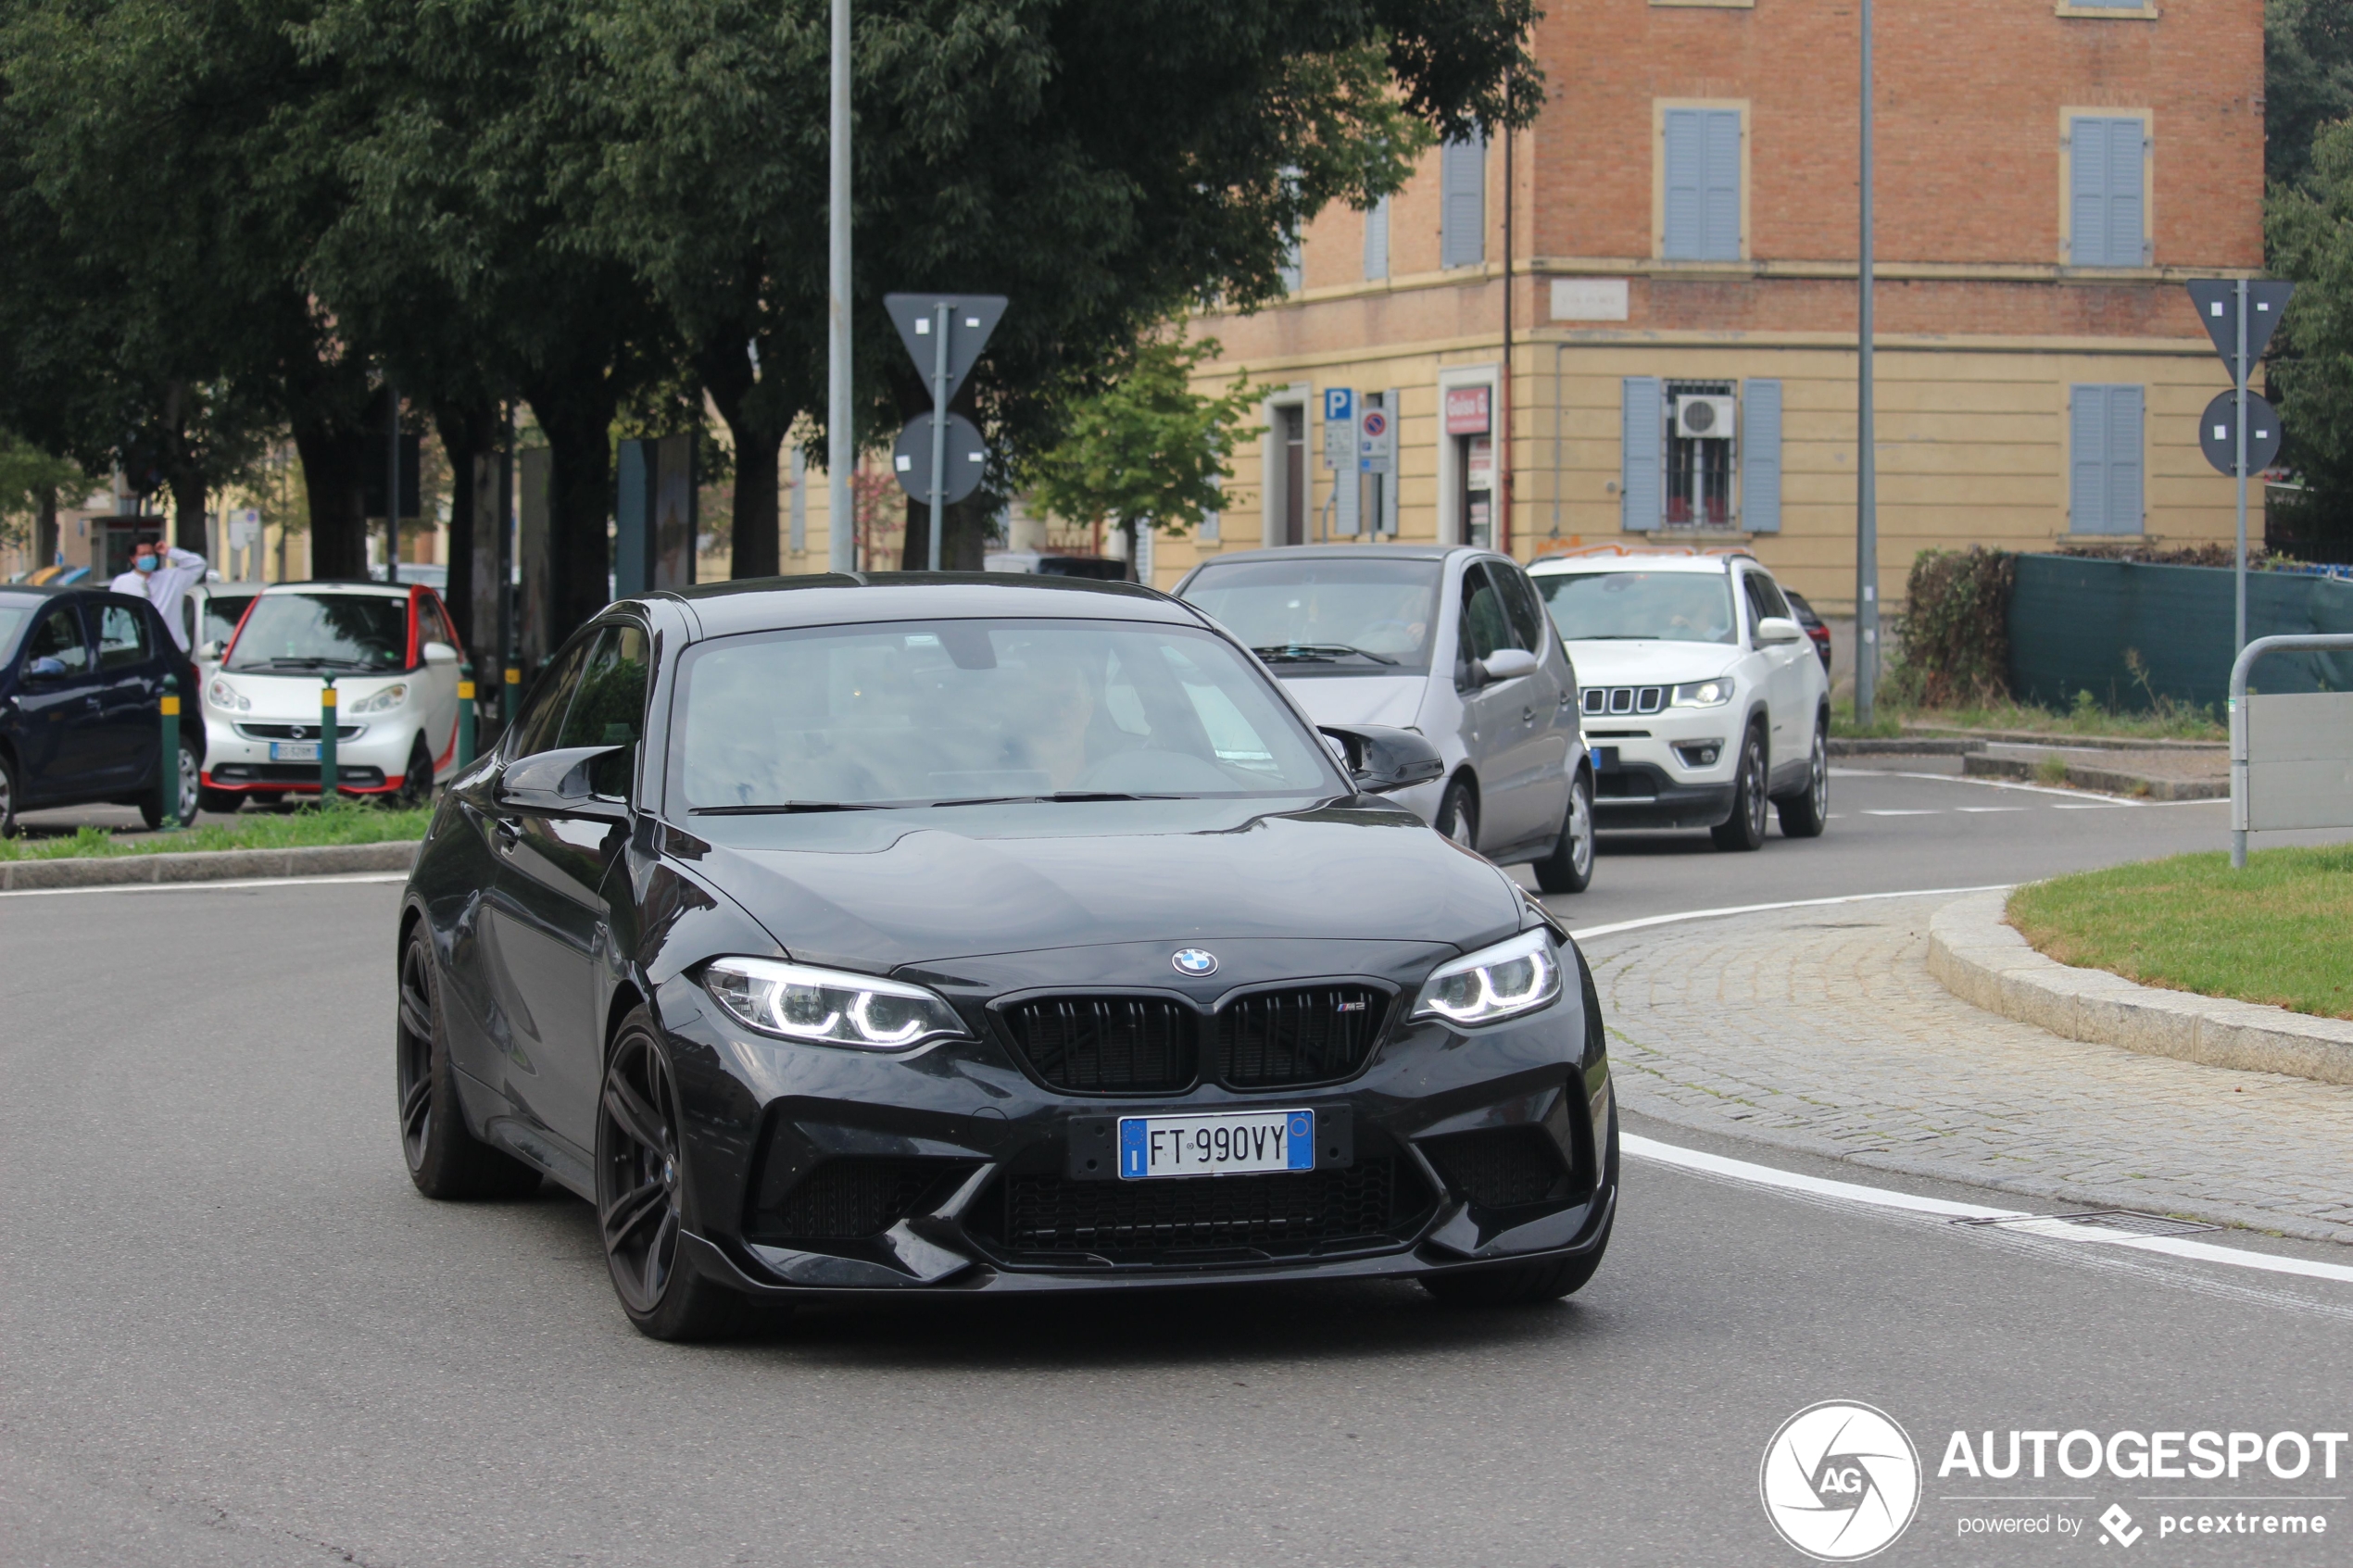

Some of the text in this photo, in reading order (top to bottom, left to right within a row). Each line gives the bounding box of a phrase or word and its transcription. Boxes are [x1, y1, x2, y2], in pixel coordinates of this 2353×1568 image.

[1328, 391, 1348, 419] P
[1150, 1124, 1285, 1166] FT 990VY
